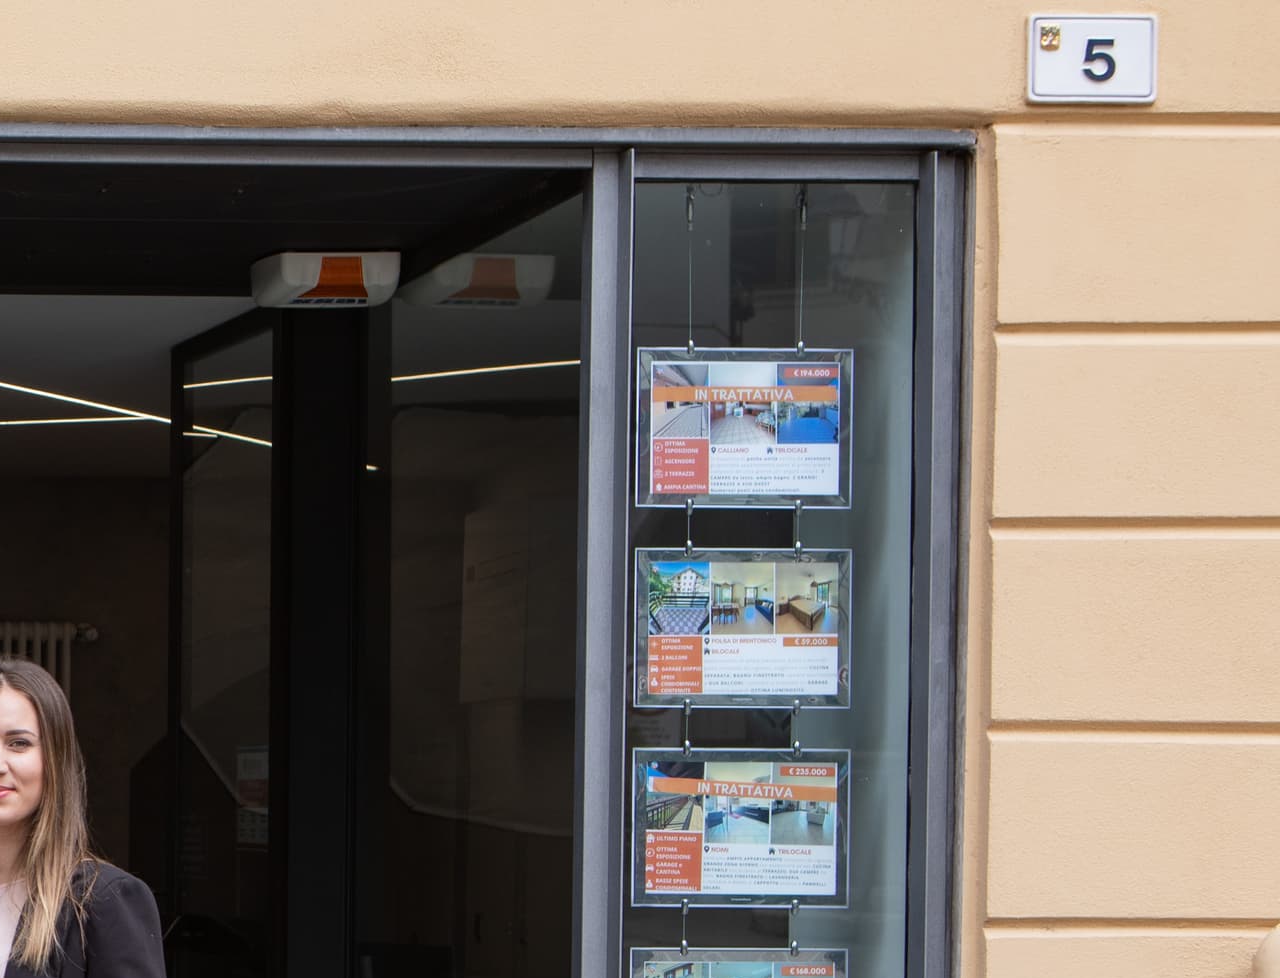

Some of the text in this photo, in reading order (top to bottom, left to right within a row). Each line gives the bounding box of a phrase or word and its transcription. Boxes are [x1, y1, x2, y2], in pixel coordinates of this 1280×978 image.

[1082, 39, 1115, 82] 5
[695, 389, 793, 400] IN TRATTATIVA
[697, 782, 793, 798] IN TRATTATIVA
